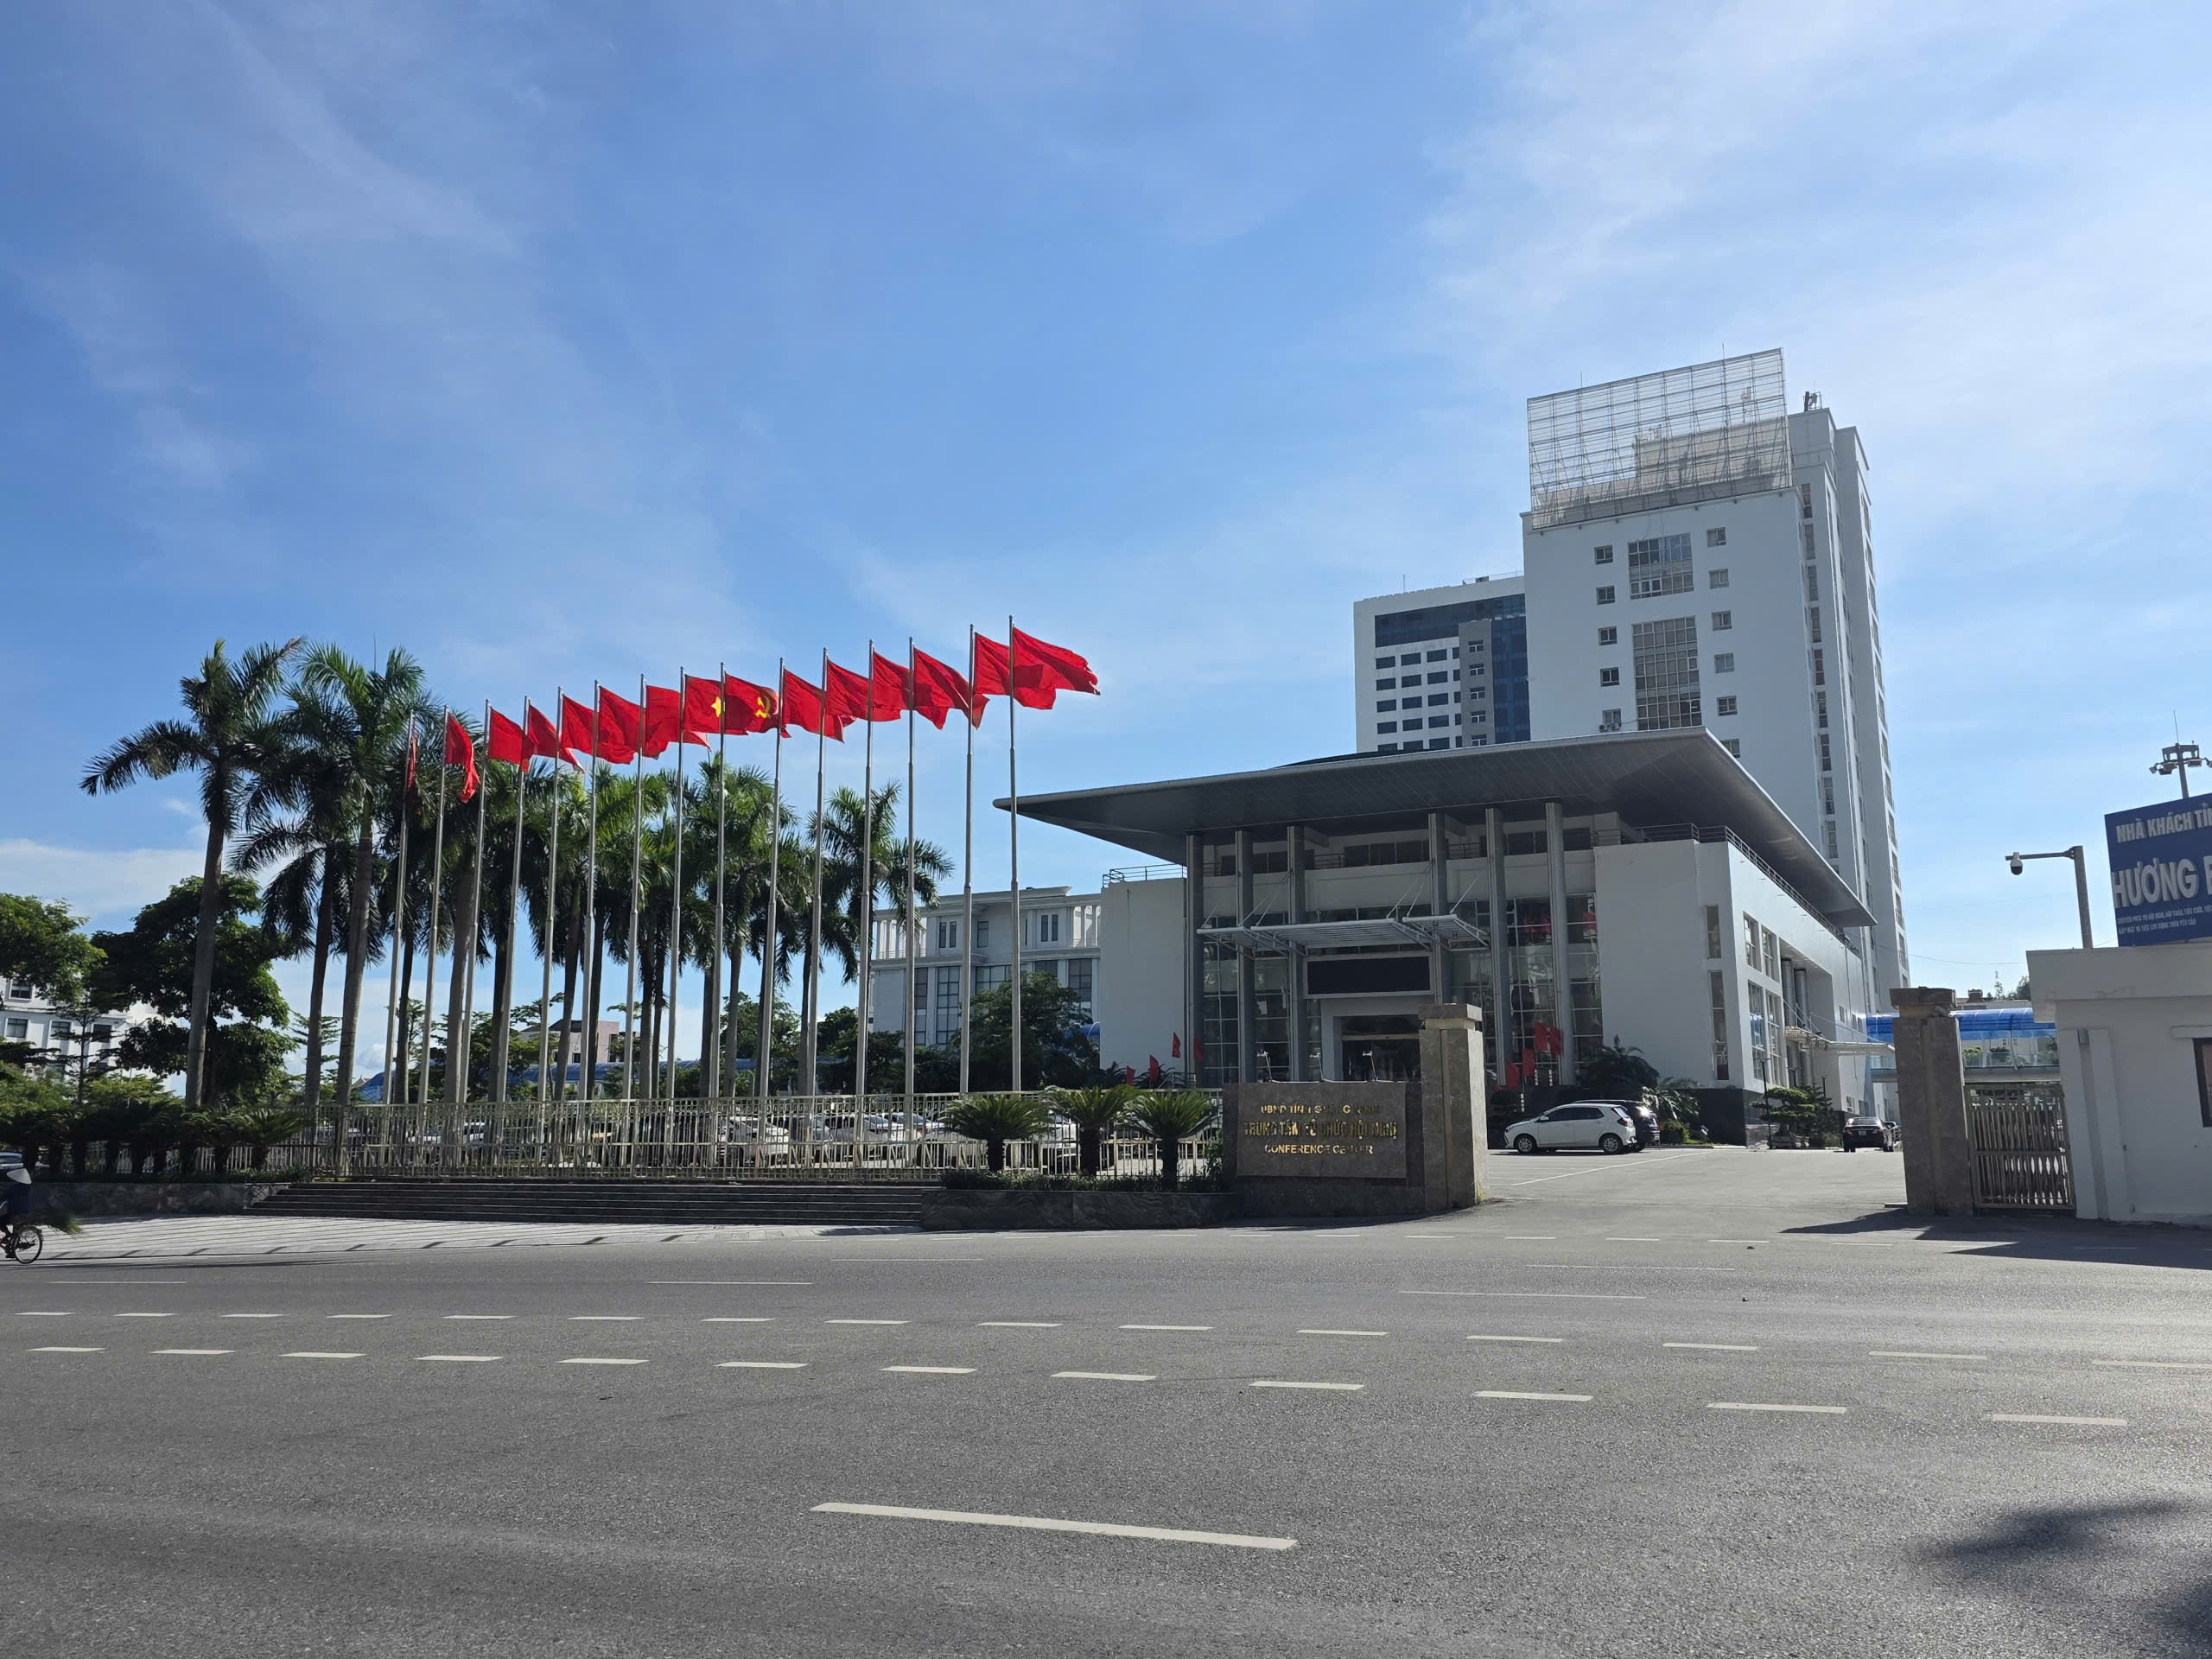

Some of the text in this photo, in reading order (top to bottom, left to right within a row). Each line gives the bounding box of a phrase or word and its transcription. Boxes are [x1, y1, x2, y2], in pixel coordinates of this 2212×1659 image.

[2116, 818, 2146, 842] NHÀ
[2147, 811, 2194, 836] KHÁCH
[2111, 857, 2199, 908] HƯƠNG
[1261, 1104, 1287, 1114] UBND
[1243, 1121, 1278, 1137] TRUNG
[1264, 1144, 1332, 1154] CONFERENCE
